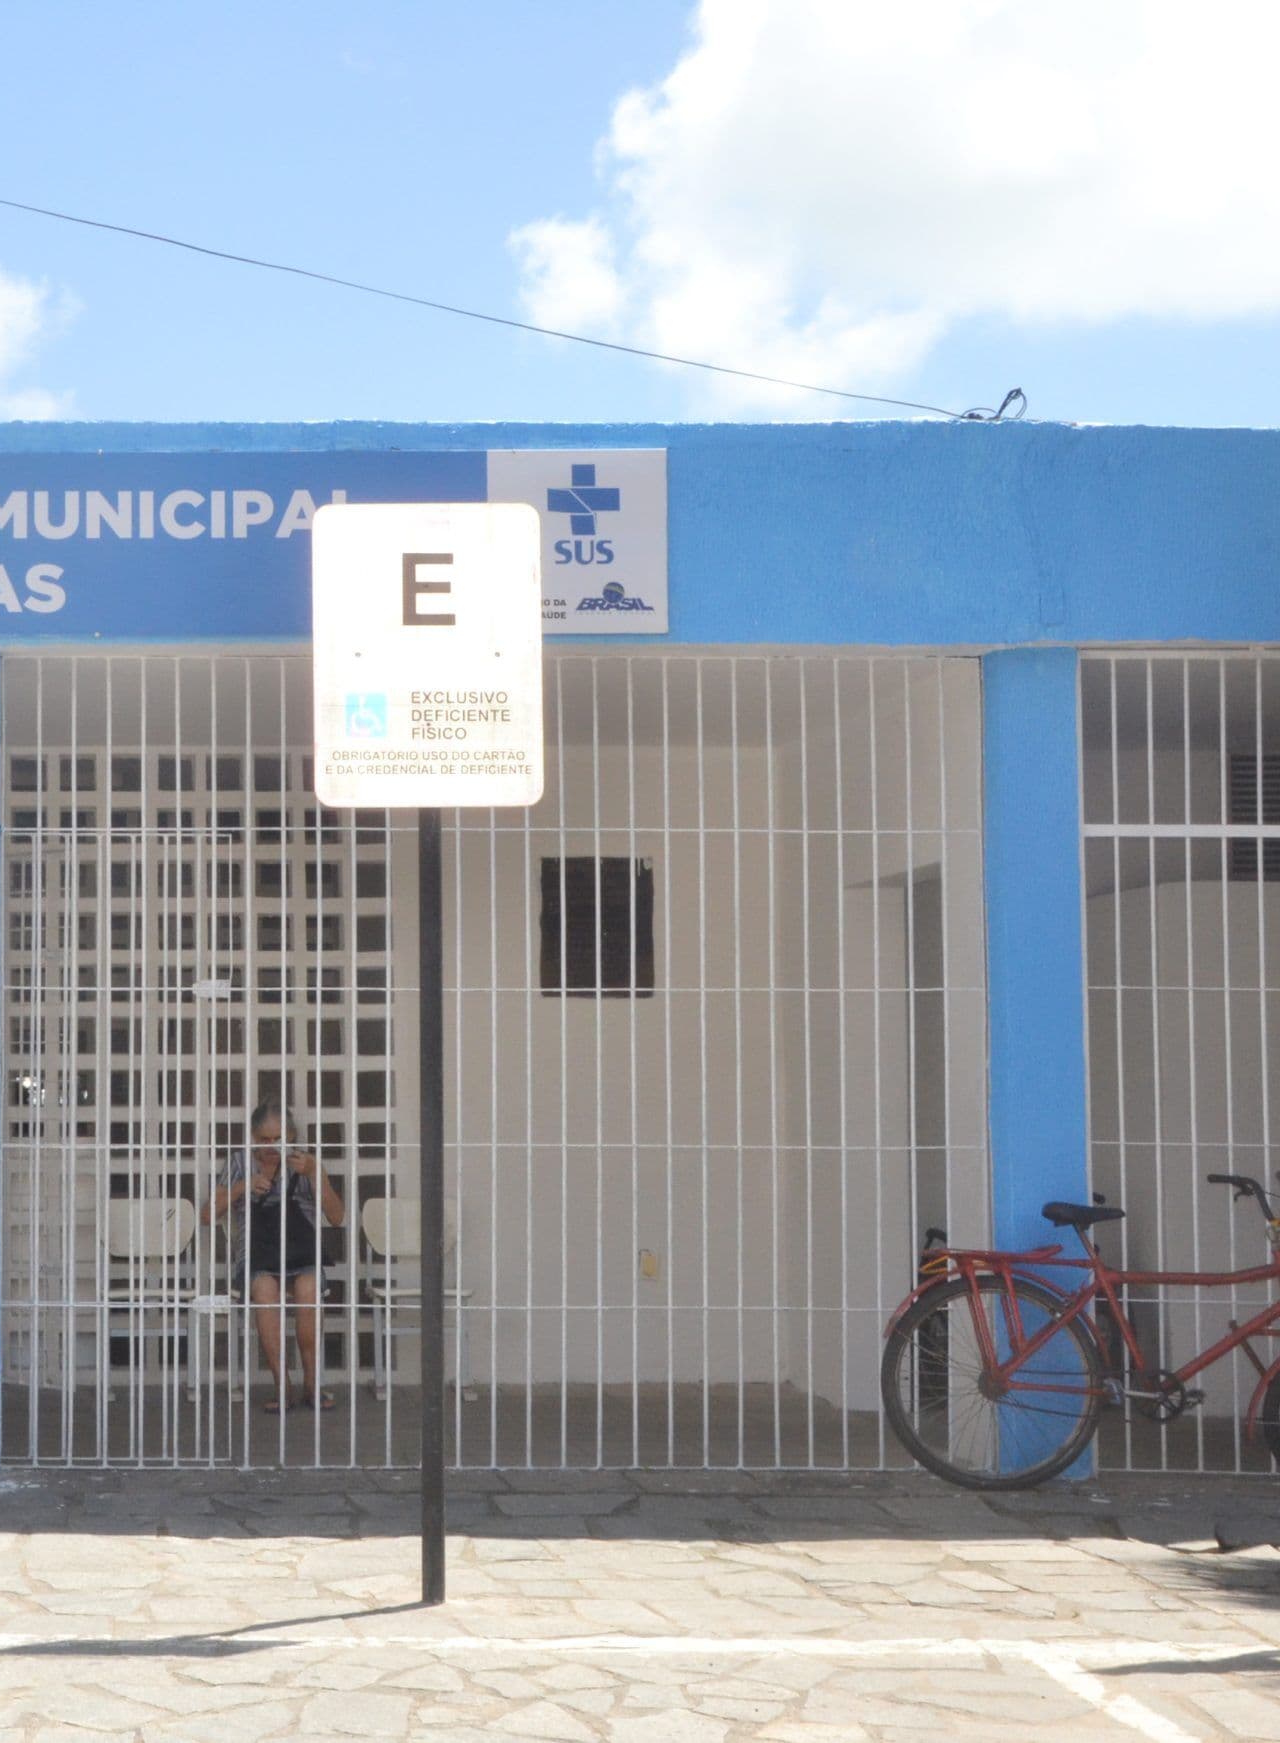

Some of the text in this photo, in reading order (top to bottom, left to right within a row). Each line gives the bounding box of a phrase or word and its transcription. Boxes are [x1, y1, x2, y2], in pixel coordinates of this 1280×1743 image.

[554, 539, 615, 566] SUS
[402, 552, 456, 626] E
[553, 599, 567, 607] DA
[576, 597, 655, 612] BRASIL
[411, 691, 509, 704] EXCLUSIVO
[411, 709, 511, 722] DEFICIENTE
[422, 751, 448, 761] USO
[452, 751, 470, 761] DO
[325, 765, 533, 775] E DA CREDENCIAL DE DEFICIENTE
